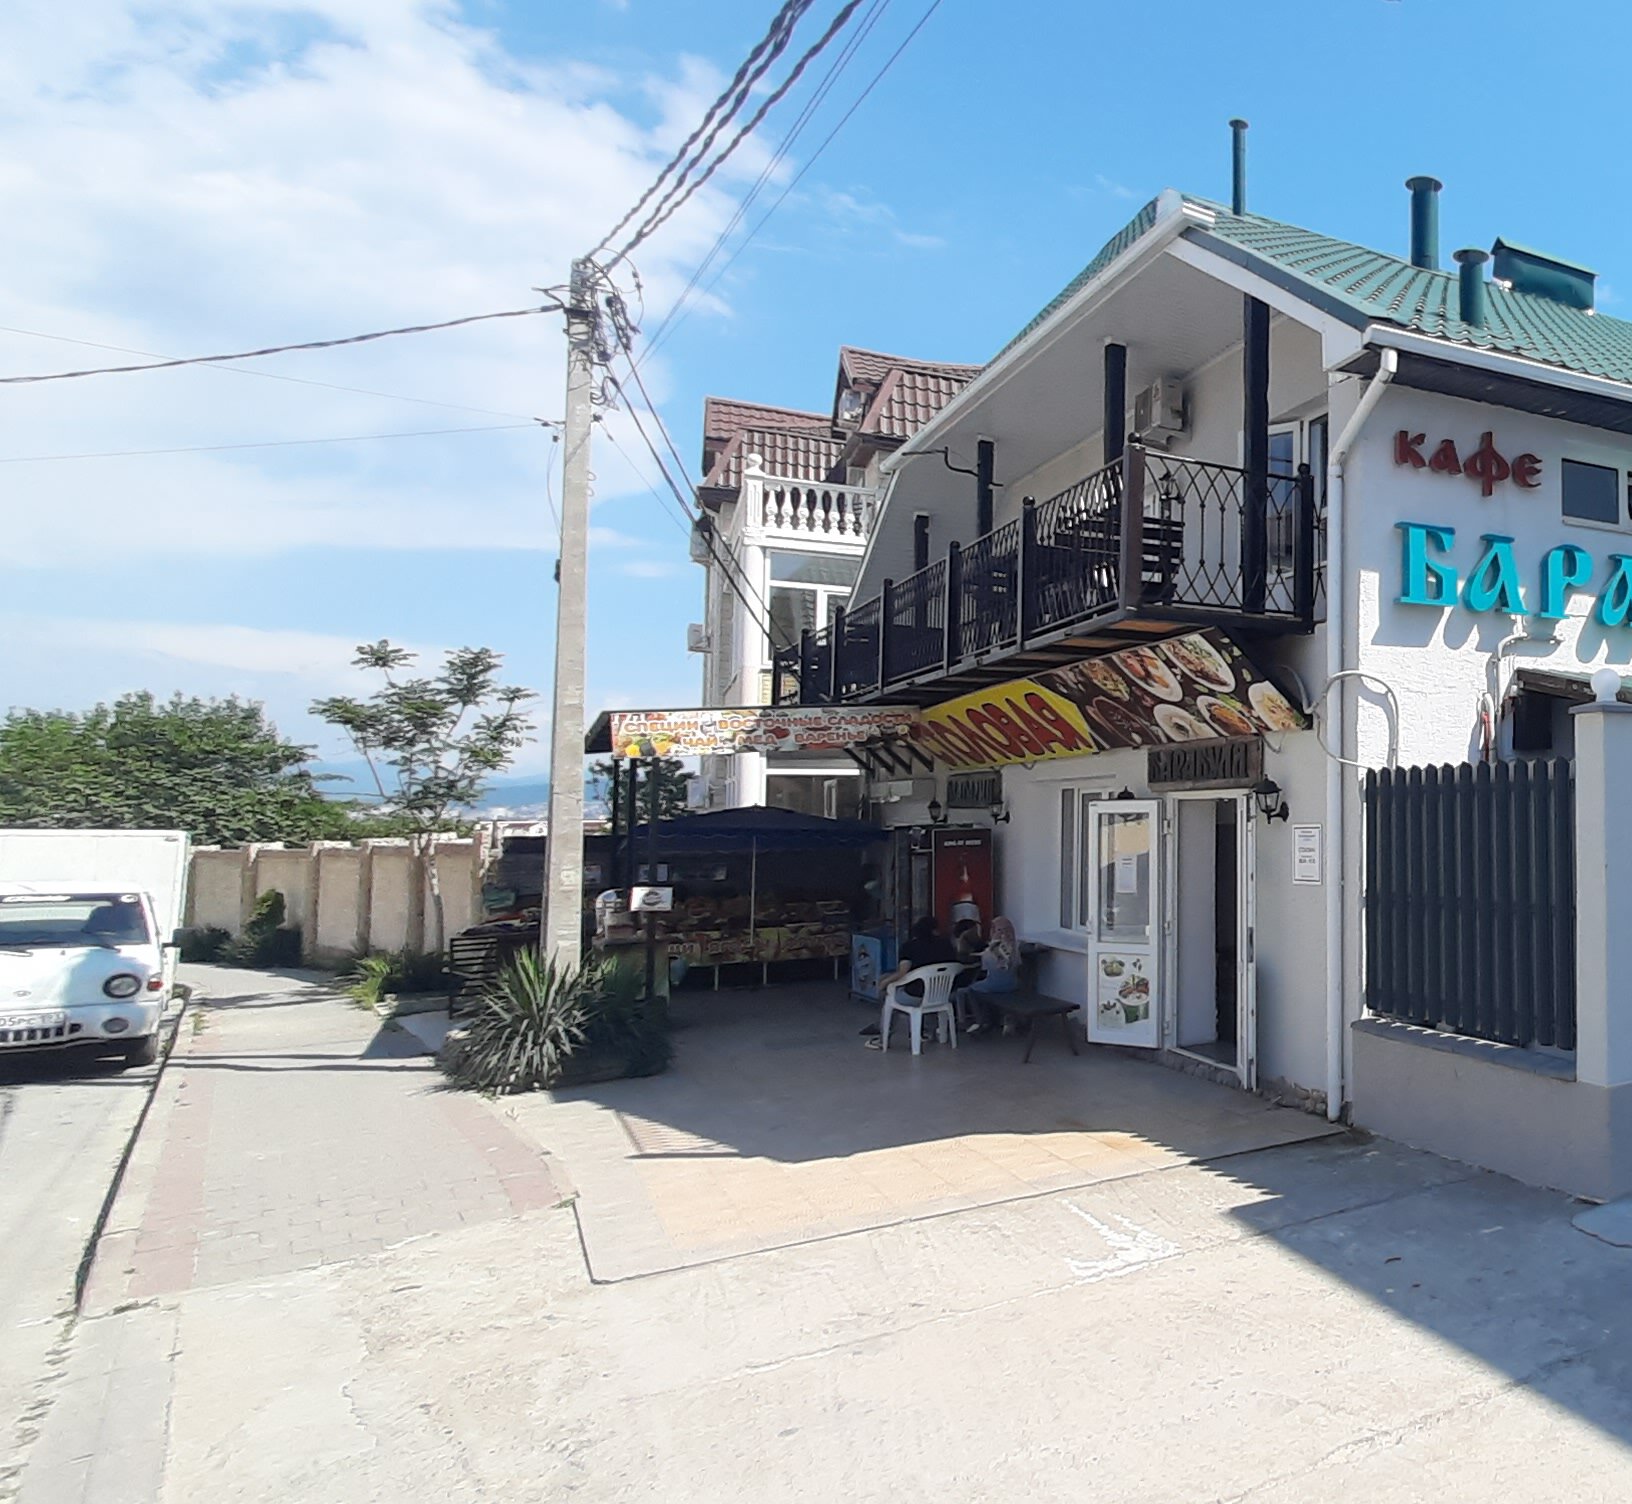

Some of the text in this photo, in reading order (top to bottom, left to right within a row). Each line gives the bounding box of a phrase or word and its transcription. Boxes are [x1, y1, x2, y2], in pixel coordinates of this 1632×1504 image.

[624, 713, 913, 733] СПЕЦИИ ВОСТОЧНЫЕ СЛАДОСТИ
[682, 730, 867, 747] ЧАЙ МЕД ВАРЕНЬЕ
